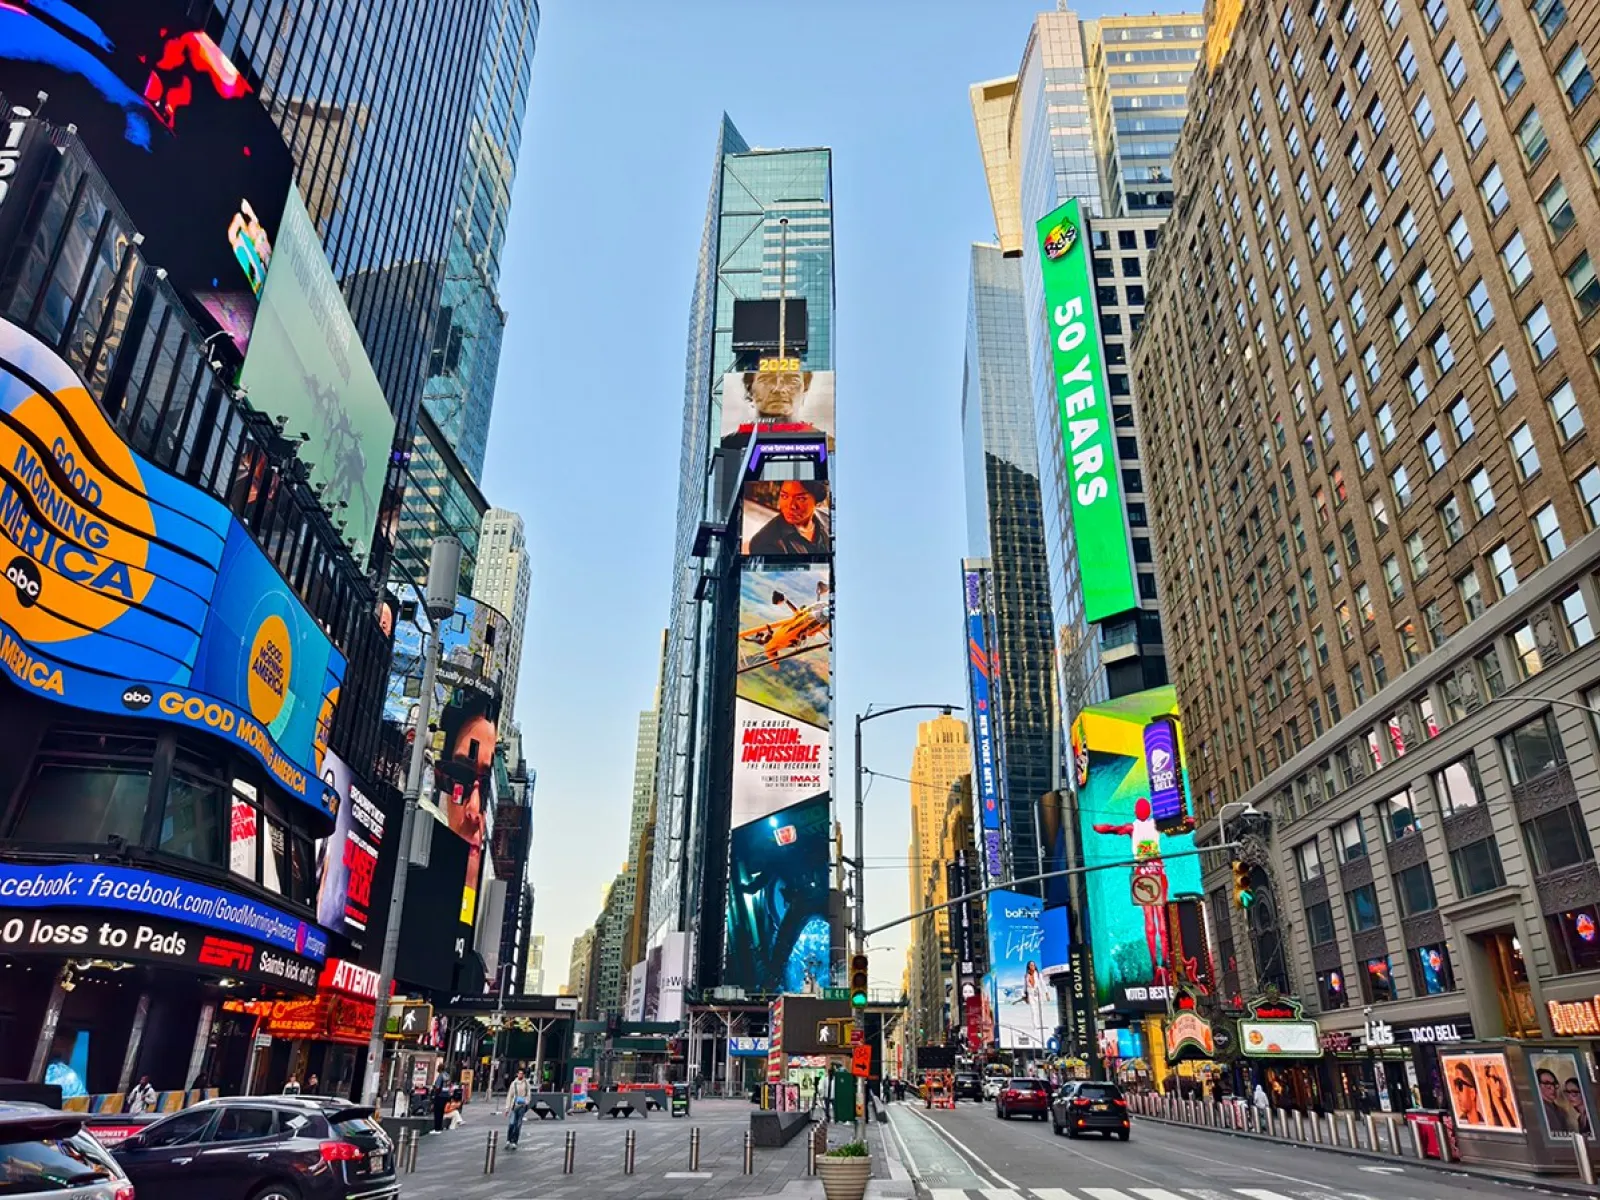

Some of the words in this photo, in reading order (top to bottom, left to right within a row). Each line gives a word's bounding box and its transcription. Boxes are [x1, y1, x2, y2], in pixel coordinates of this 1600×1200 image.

[1054, 296, 1087, 352] 50
[759, 359, 800, 371] 2025
[1061, 357, 1108, 507] YEARS
[53, 436, 103, 509] GOOD
[13, 444, 110, 549] MORNING
[6, 567, 39, 597] abc
[259, 646, 284, 680] MORNING
[266, 640, 283, 664] GOOD
[252, 657, 283, 698] AMERICA
[742, 728, 802, 745] MISSION:
[761, 720, 790, 728] CRUISE
[979, 714, 988, 737] NEW
[123, 692, 152, 704] abc
[159, 691, 235, 732] GOOD
[236, 717, 275, 767] MORNING
[271, 755, 307, 796] AMERICA
[741, 745, 821, 763] IMPOSSIBLE
[981, 738, 991, 765] YORK
[790, 775, 821, 783] IMAX
[982, 766, 993, 796] METS
[1152, 770, 1174, 783] TACO
[1154, 778, 1176, 792] BELL
[0, 871, 84, 898] cebook:
[29, 918, 90, 944] loss
[99, 922, 128, 948] to
[134, 925, 187, 956] Pads
[198, 935, 255, 972] ESPN
[259, 950, 285, 976] Saints
[1071, 953, 1084, 999] SQUARE
[835, 988, 844, 998] 44
[270, 1020, 293, 1030] BAKE
[293, 1021, 316, 1031] SHOP
[1076, 1009, 1089, 1046] TIMES
[1548, 1000, 1599, 1035] BUBBA
[1365, 1020, 1395, 1046] Lids
[1409, 1027, 1435, 1043] TACO
[1435, 1024, 1461, 1042] BELL
